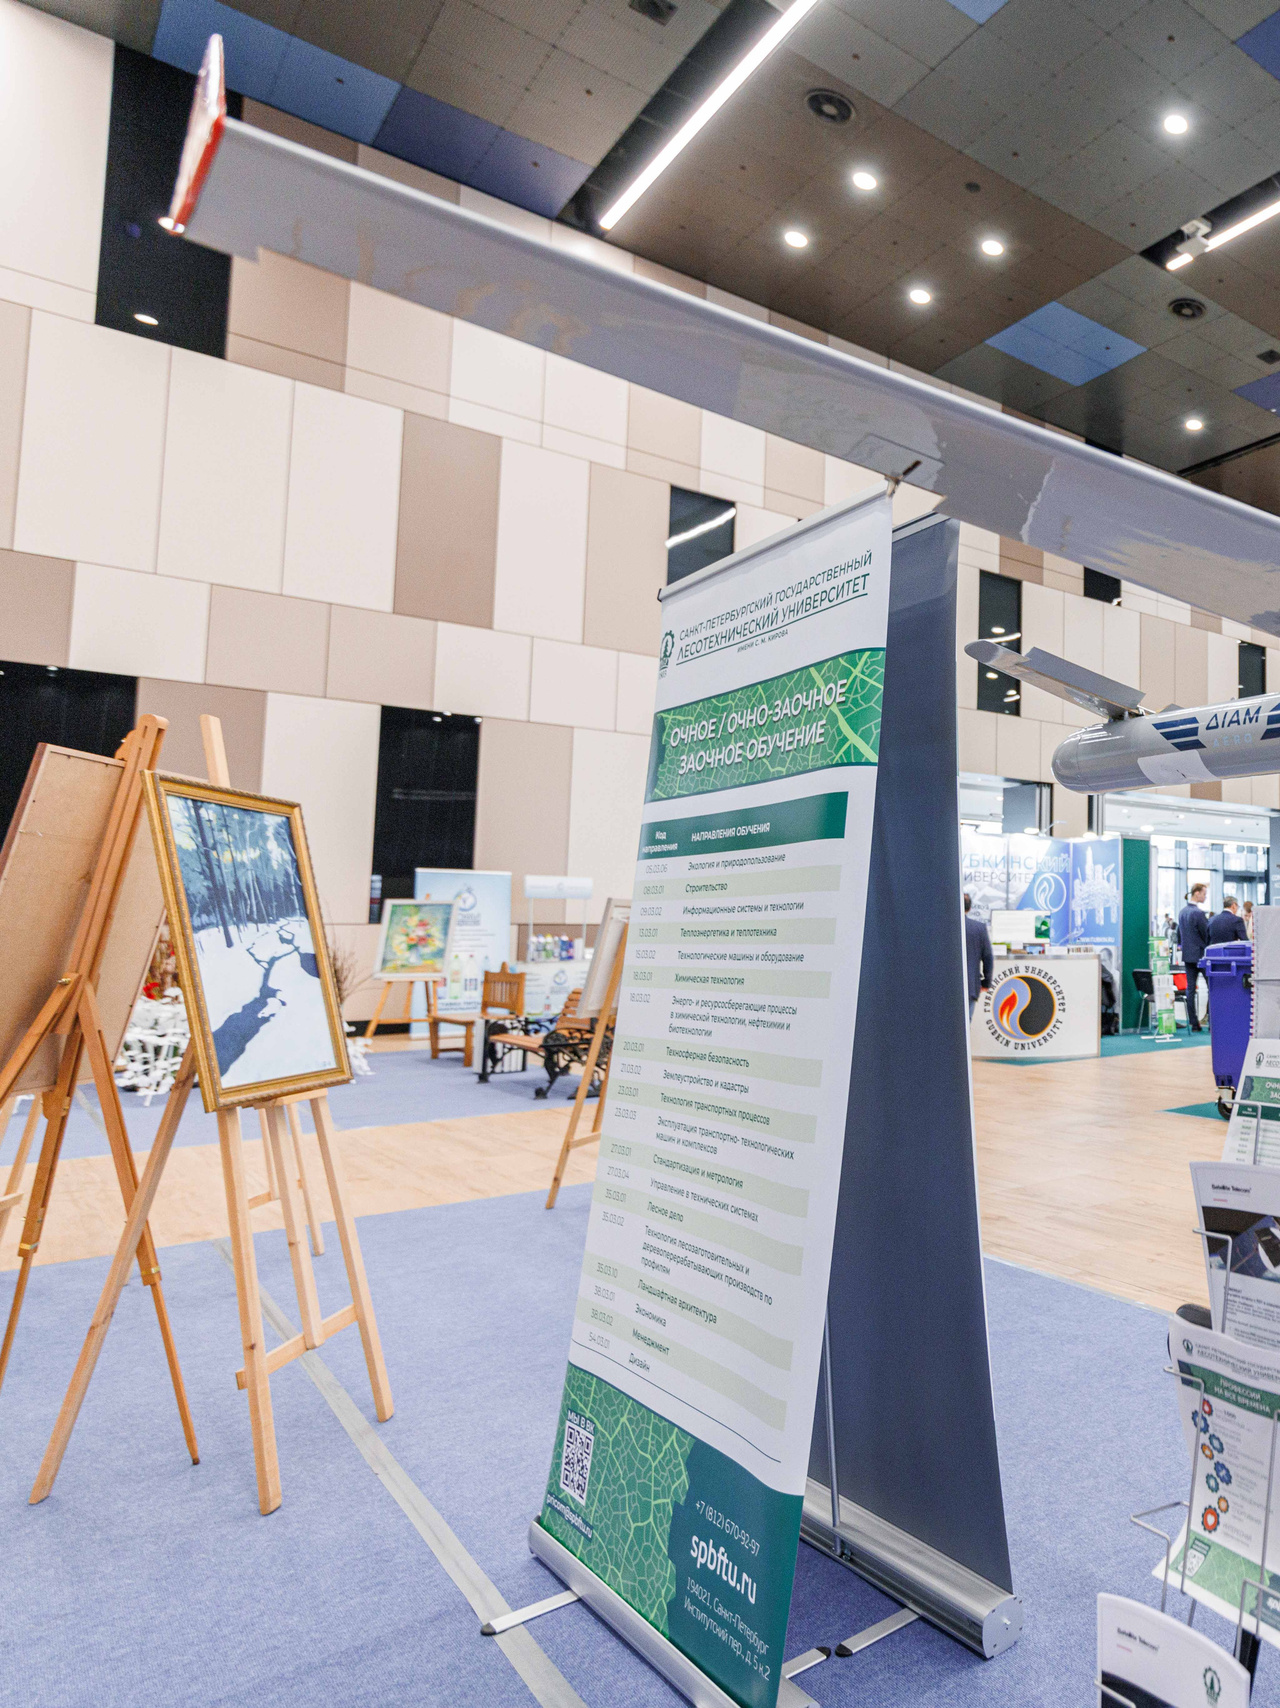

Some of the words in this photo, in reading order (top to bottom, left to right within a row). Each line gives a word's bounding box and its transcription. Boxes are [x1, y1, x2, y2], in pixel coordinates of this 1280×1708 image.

[680, 592, 773, 641] САНКТ-ПЕТЕРБУРГСКИЙ
[775, 550, 872, 604] ГОСУДАРСТВЕННЫЙ
[677, 608, 779, 660] ЛЕСОТЕХНИЧЕСКИЙ
[781, 573, 870, 623] УНИВЕРСИТЕТ
[737, 641, 754, 652] ИМЕНИ
[768, 629, 788, 642] КИРОВА
[670, 717, 717, 747] ОЧНОЕ
[718, 712, 727, 735] /
[727, 679, 847, 733] ОЧНО-ЗАОЧНОЕ
[679, 742, 743, 775] ЗАОЧНОЕ
[747, 720, 826, 760] ОБУЧЕНИЕ
[1213, 733, 1253, 748] AERO
[656, 831, 666, 840] Код
[692, 827, 735, 842] НАПРАВЛЕНИЯ
[736, 823, 770, 836] ОБУЧЕНИЯ
[646, 864, 668, 874] 05.03.06
[688, 862, 715, 871] Экология
[721, 853, 786, 868] природопользование
[643, 885, 664, 894] 08.03.01
[685, 883, 727, 893] Строительство
[640, 907, 662, 916] 09.03.02
[683, 905, 736, 917] Информационные
[737, 904, 763, 913] системы
[769, 902, 804, 911] технологии
[681, 928, 730, 938] Теплоэнергетика
[736, 928, 777, 936] теплотехника
[678, 951, 727, 961] Технологические
[729, 953, 754, 961] машины
[760, 952, 804, 963] оборудование
[675, 973, 709, 985] Химическая
[710, 977, 744, 986] технология
[672, 996, 694, 1008] Энерго-
[701, 999, 766, 1014] ресурсосберегающие
[767, 1005, 797, 1016] процессы
[669, 1023, 712, 1037] биотехнологии
[675, 1012, 710, 1022] химической
[711, 1015, 747, 1027] технологии,
[748, 1019, 785, 1030] нефтехимии
[986, 1019, 1011, 1048] GUBKIN
[1014, 1018, 1063, 1050] UNIVERSITY
[666, 1046, 706, 1061] Техносферная
[708, 1052, 750, 1068] безопасность
[663, 1070, 713, 1088] Землеустройство
[720, 1081, 749, 1094] кадастры
[660, 1093, 693, 1107] Технология
[694, 1099, 737, 1117] транспортных
[738, 1110, 770, 1126] процессов
[655, 1132, 675, 1143] машин
[682, 1139, 717, 1155] комплексов
[657, 1116, 697, 1133] Эксплуатация
[699, 1124, 740, 1144] транспортно-
[741, 1137, 794, 1160] технологических
[653, 1154, 700, 1176] Стандартизация
[707, 1170, 743, 1189] метрология
[650, 1178, 684, 1198] Управление
[691, 1192, 729, 1211] технических
[730, 1204, 758, 1222] системах
[647, 1202, 668, 1216] Лесное
[669, 1210, 683, 1222] дело
[645, 1225, 677, 1246] Технология
[678, 1234, 744, 1273] лесозаготовительных
[641, 1255, 671, 1275] профилям
[642, 1241, 723, 1282] деревоперерабатывающих
[725, 1274, 763, 1299] производств
[764, 1296, 772, 1305] по
[638, 1279, 678, 1305] Ландшафтная
[679, 1298, 717, 1324] архитектура
[635, 1304, 667, 1327] Экономика
[632, 1328, 669, 1355] Менеджмент
[629, 1352, 650, 1372] Дизайн
[568, 1410, 580, 1426] МЫ
[695, 1500, 706, 1515] +7
[705, 1504, 725, 1530] (812)
[724, 1518, 761, 1557] 670-92-97
[690, 1534, 757, 1605] spbftu.ru
[684, 1595, 729, 1643] Институтский
[687, 1576, 712, 1610] 194021,
[713, 1597, 770, 1655] Санкт-Петербург
